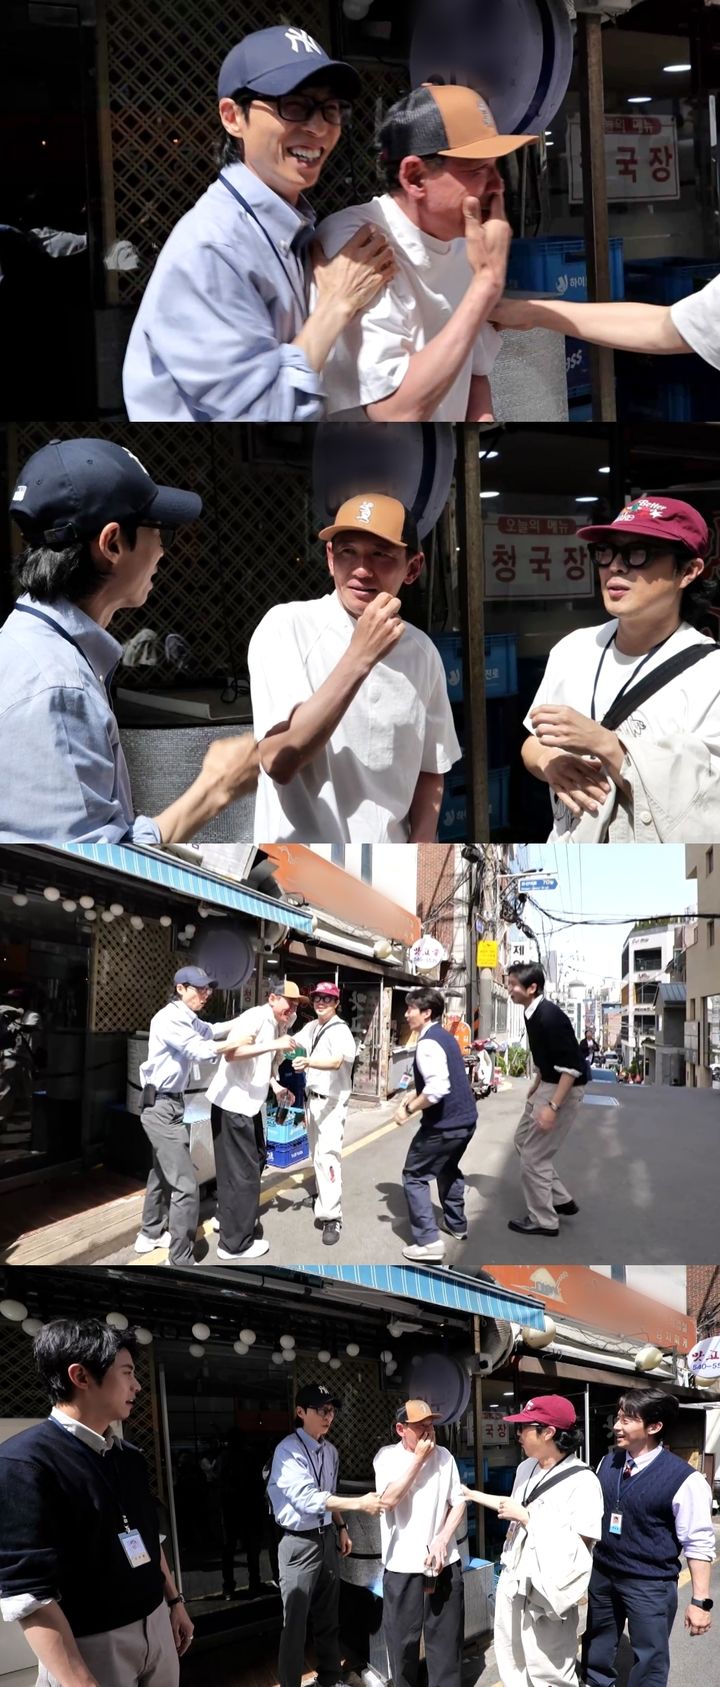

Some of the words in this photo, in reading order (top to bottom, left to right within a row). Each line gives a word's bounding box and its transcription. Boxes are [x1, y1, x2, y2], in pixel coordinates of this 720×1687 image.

[284, 27, 322, 55] NY
[569, 275, 586, 288] 하이
[638, 499, 667, 511] Better
[506, 518, 541, 534] 오늘의
[547, 519, 569, 534] 메뉴
[491, 543, 588, 583] 청국장
[484, 667, 499, 681] 진로
[485, 1423, 507, 1439] 국장
